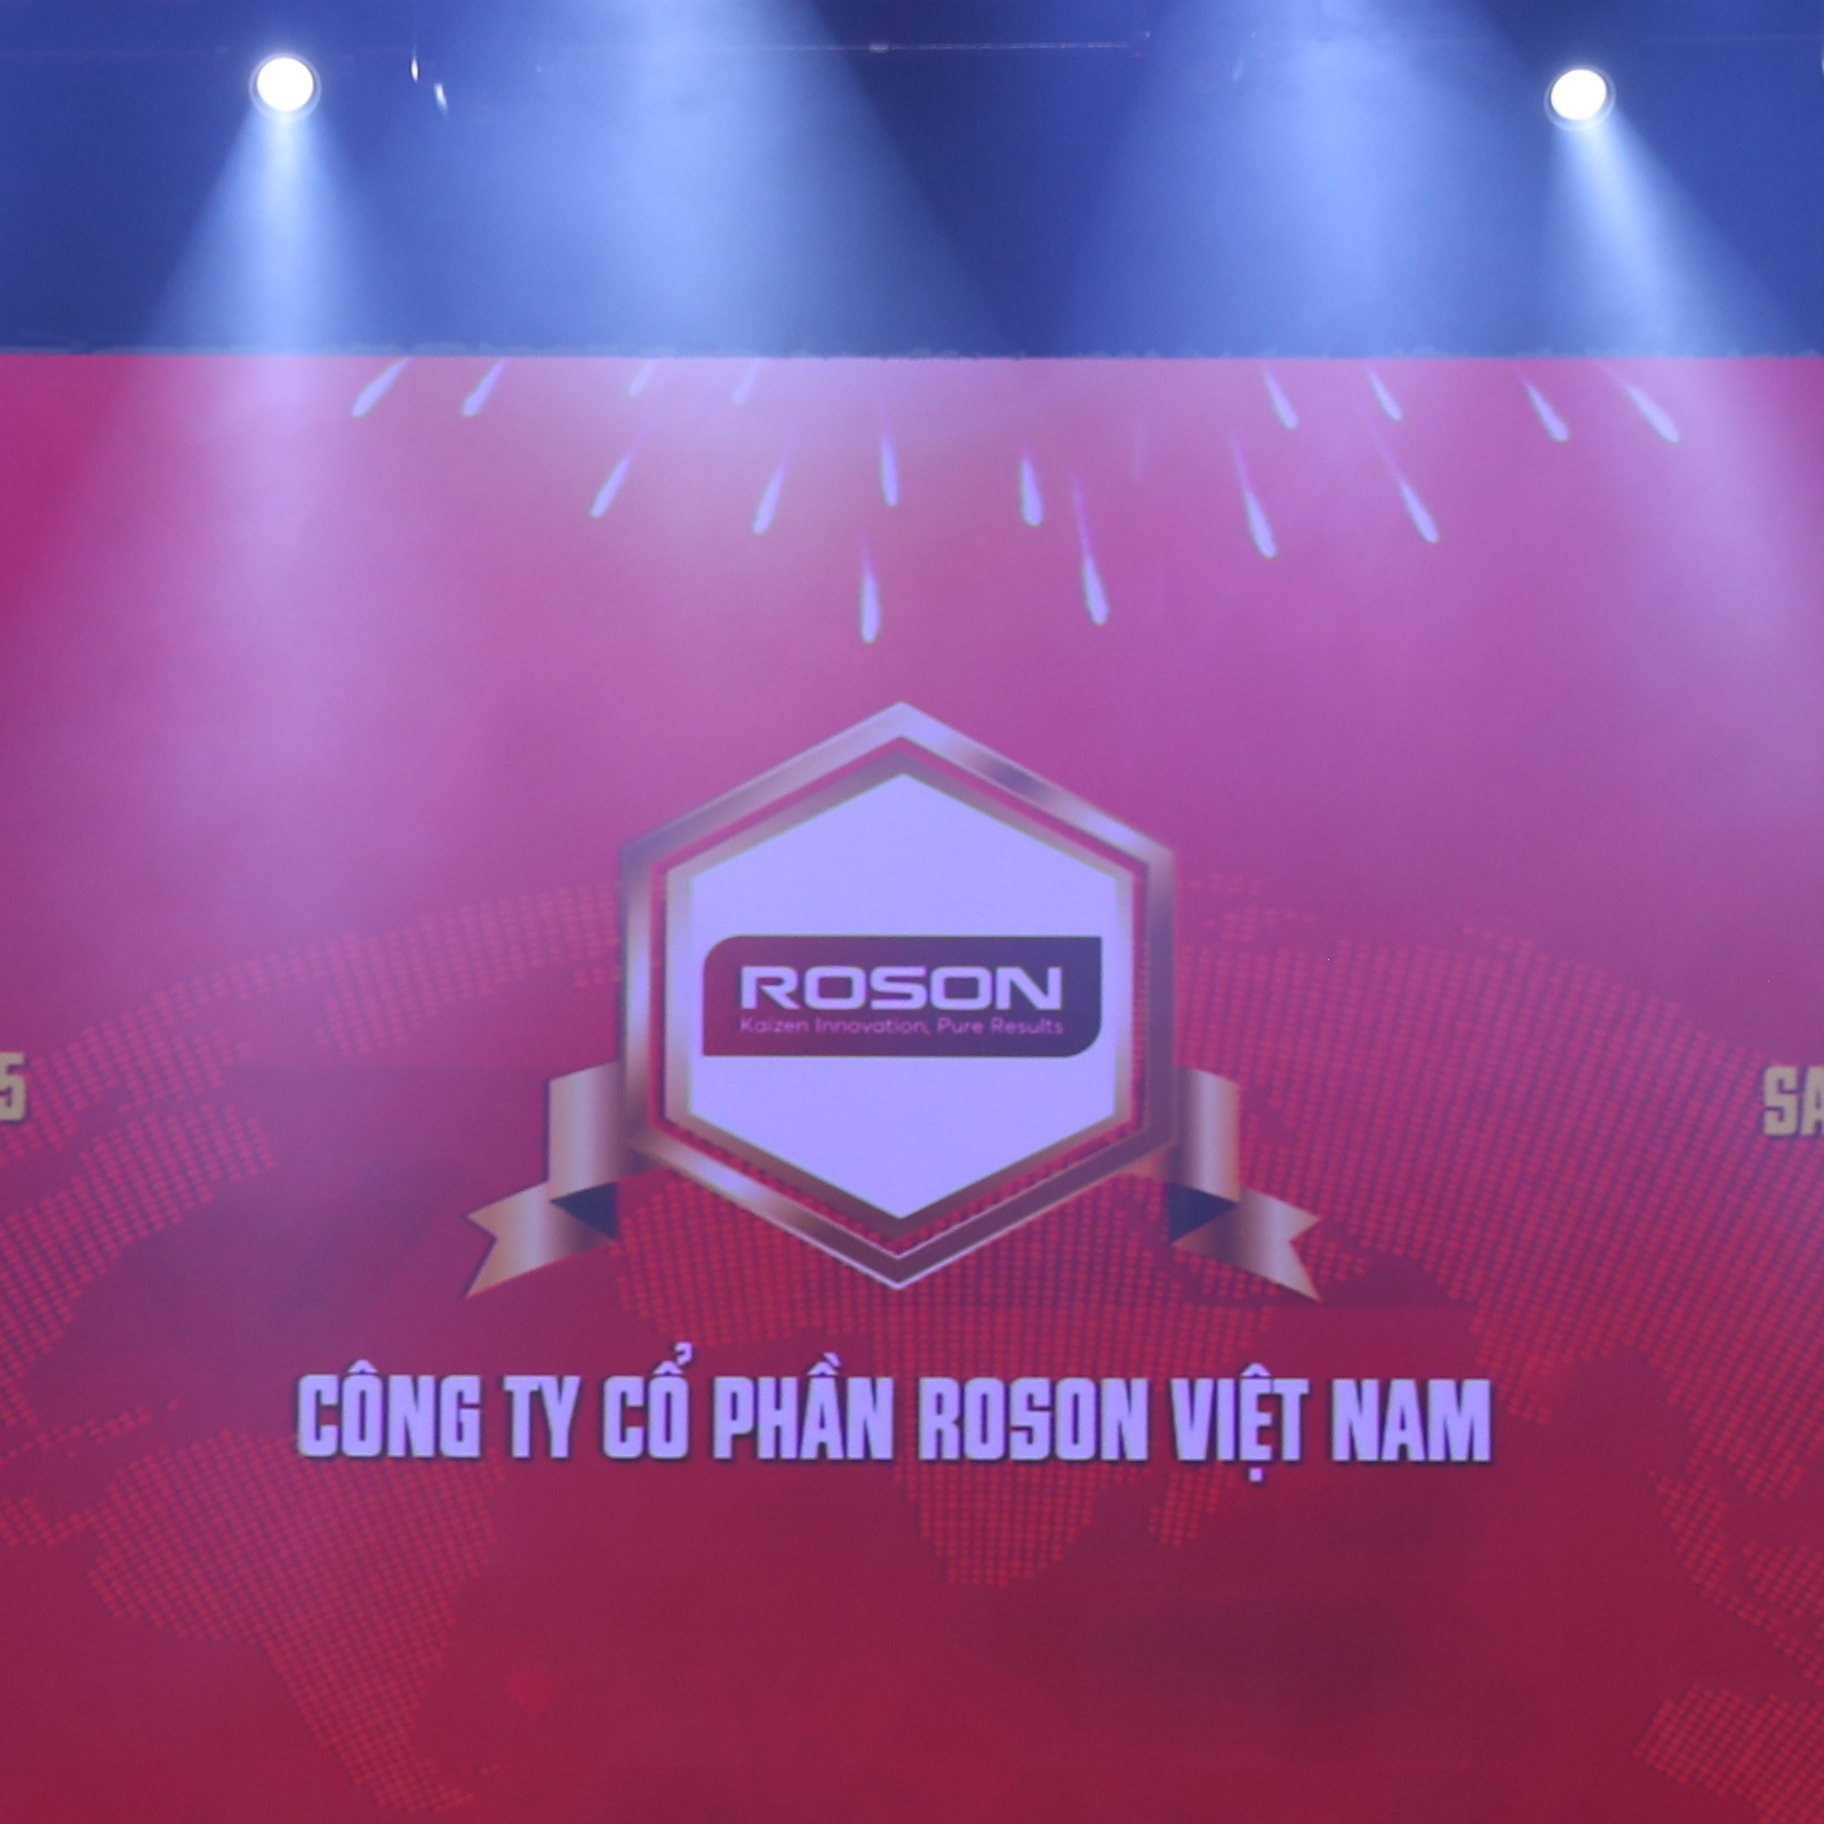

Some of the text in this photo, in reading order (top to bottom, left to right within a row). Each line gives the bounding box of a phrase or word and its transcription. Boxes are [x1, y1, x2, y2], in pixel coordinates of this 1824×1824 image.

[741, 966, 1062, 1010] ROSON
[740, 1017, 1064, 1036] Kaizen Innovation, Pure Results
[298, 1342, 1491, 1482] CÔNG TY CỔ PHẦN ROSON VIỆT NAM
